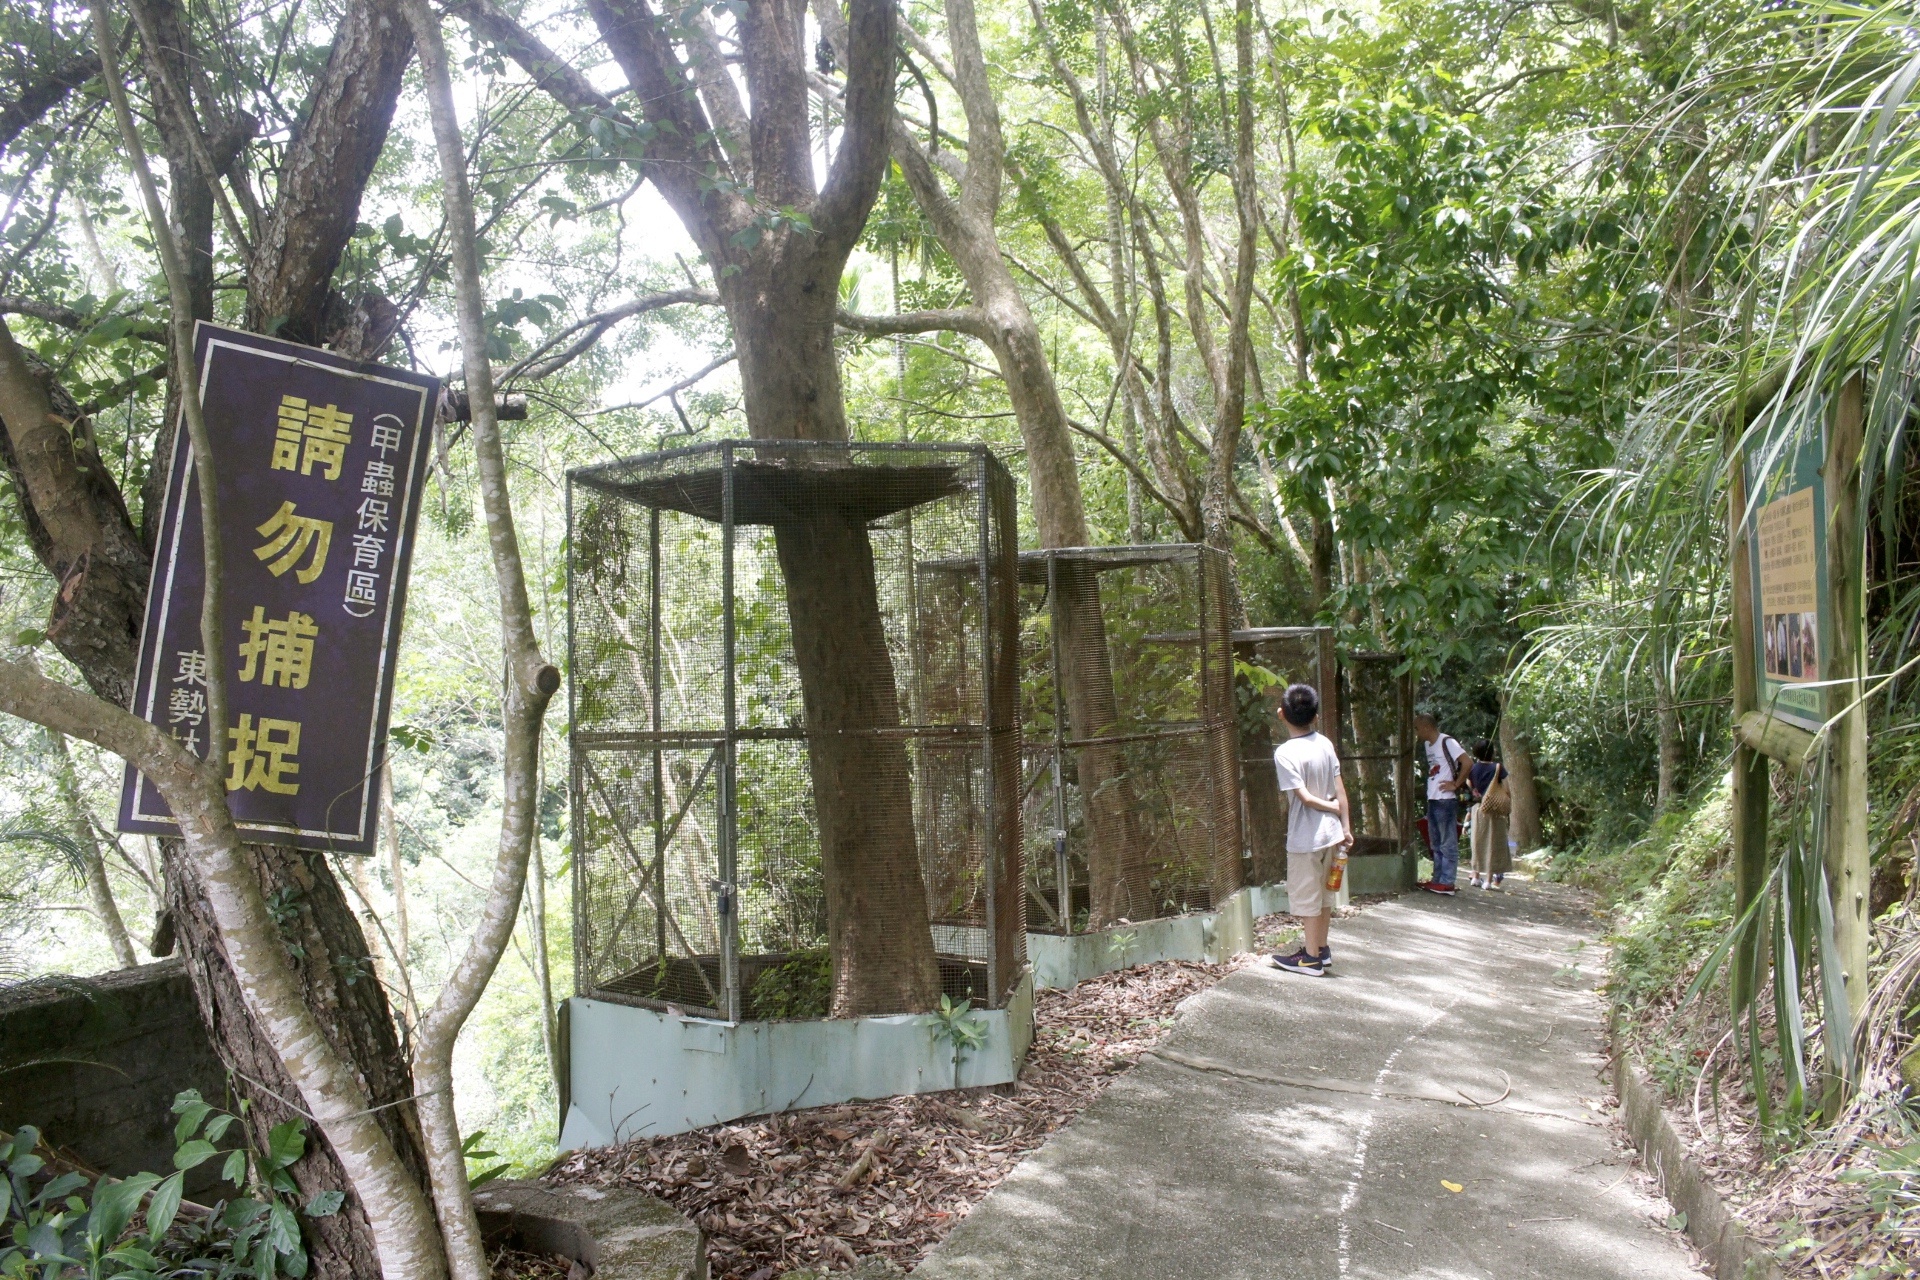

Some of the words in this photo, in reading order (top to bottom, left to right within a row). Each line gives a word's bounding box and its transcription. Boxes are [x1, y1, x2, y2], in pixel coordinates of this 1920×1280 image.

[225, 394, 354, 796] 請勿捕捉
[342, 413, 405, 618] （甲蟲保育區）
